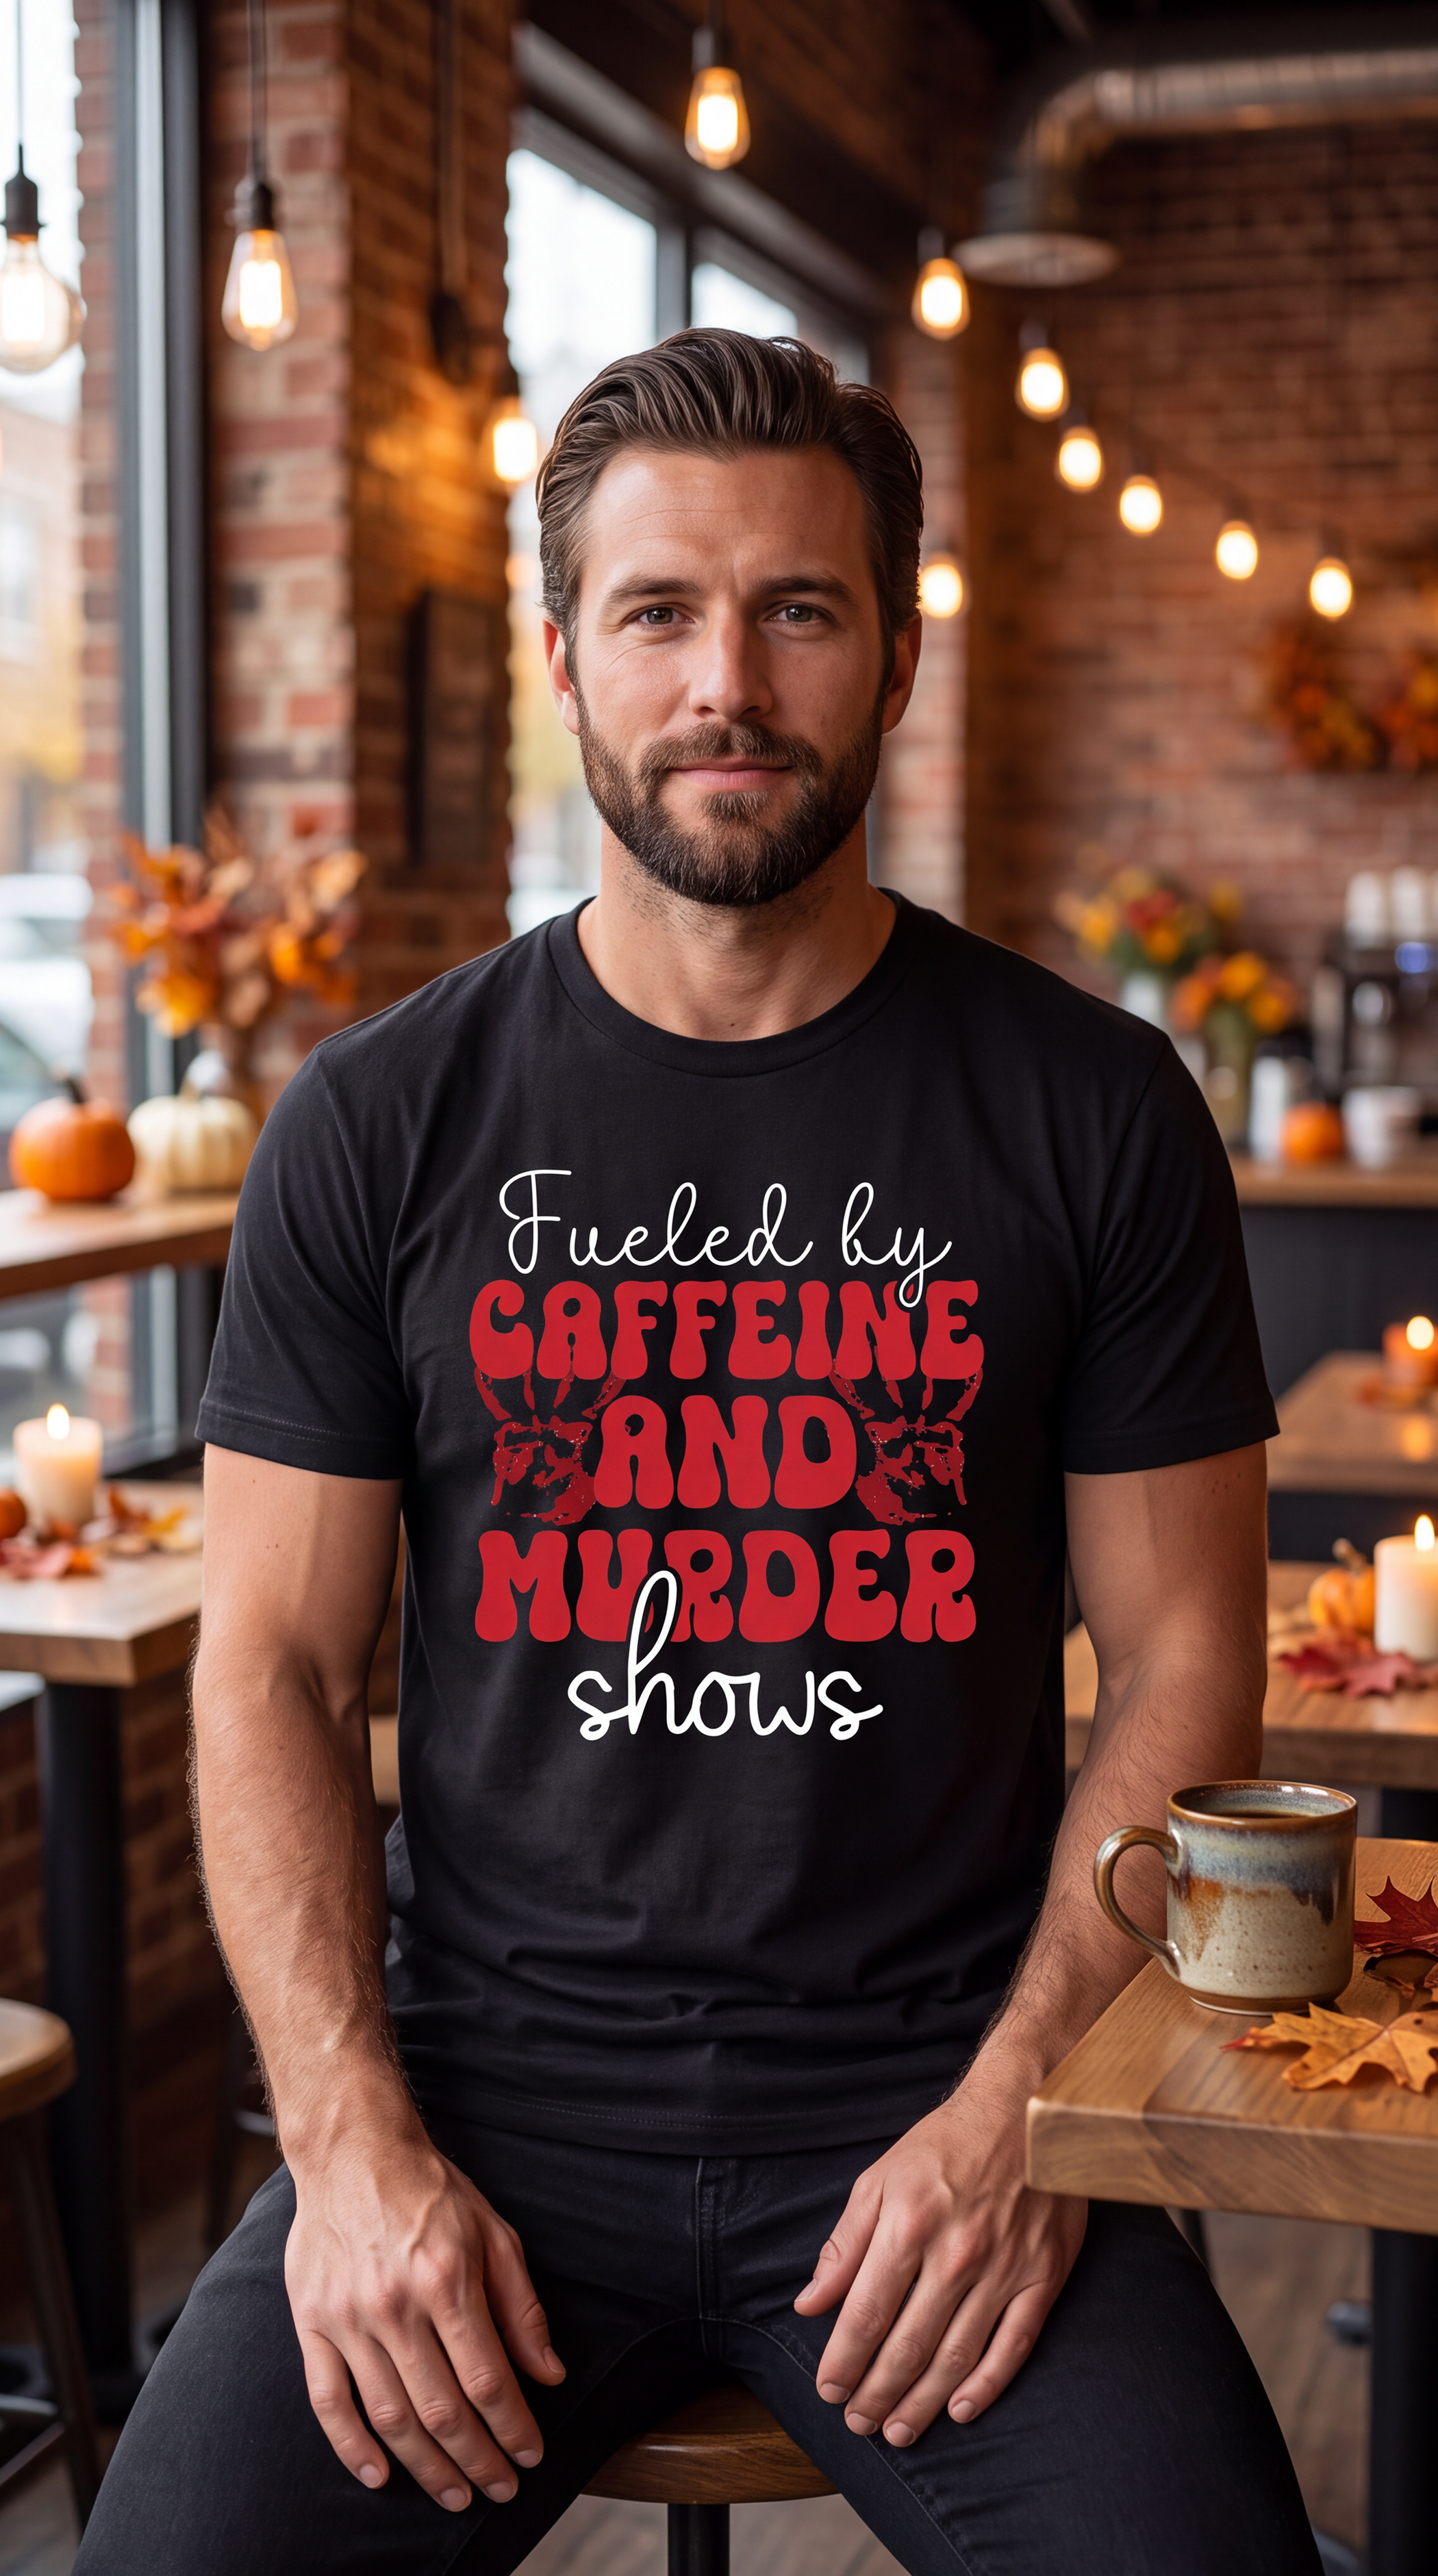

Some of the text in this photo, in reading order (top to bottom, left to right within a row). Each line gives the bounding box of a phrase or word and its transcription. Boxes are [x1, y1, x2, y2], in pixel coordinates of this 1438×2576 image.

[499, 1169, 953, 1308] Fueled by
[470, 1280, 985, 1380] CAFFEINE
[593, 1394, 857, 1509] AND
[475, 1529, 976, 1643] MURDER
[567, 1570, 884, 1741] shows
